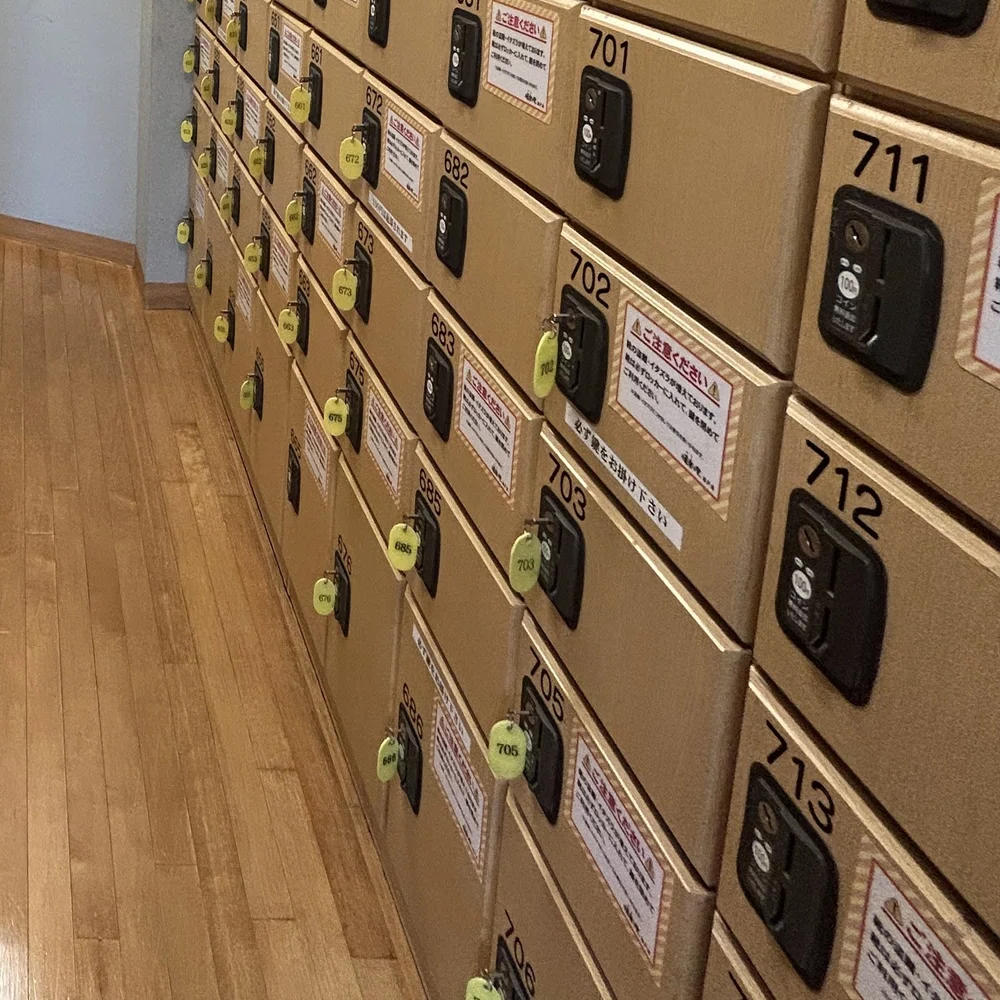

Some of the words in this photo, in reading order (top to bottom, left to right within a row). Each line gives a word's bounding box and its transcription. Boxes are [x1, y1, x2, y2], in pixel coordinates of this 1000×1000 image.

[311, 43, 323, 65] 661
[589, 27, 629, 74] 701
[366, 86, 383, 116] 672
[304, 160, 317, 186] 662
[345, 154, 360, 164] 672
[444, 149, 470, 190] 682
[853, 130, 929, 203] 711
[357, 222, 374, 255] 673
[338, 286, 352, 296] 673
[570, 249, 611, 309] 702
[431, 312, 455, 356] 683
[350, 351, 365, 386] 675
[642, 327, 708, 389] ご注意ください
[328, 414, 343, 423] 675
[419, 468, 442, 516] 685
[550, 452, 587, 521] 703
[574, 419, 668, 528] 必ず鍵をお掛け下さい
[806, 439, 883, 540] 712
[337, 534, 352, 575] 676
[394, 541, 412, 555] 685
[518, 560, 535, 571] 703
[318, 594, 331, 603] 676
[530, 646, 564, 722] 705
[402, 682, 424, 740] 686
[497, 743, 519, 757] 705
[766, 719, 835, 834] 713
[504, 910, 536, 998] 706
